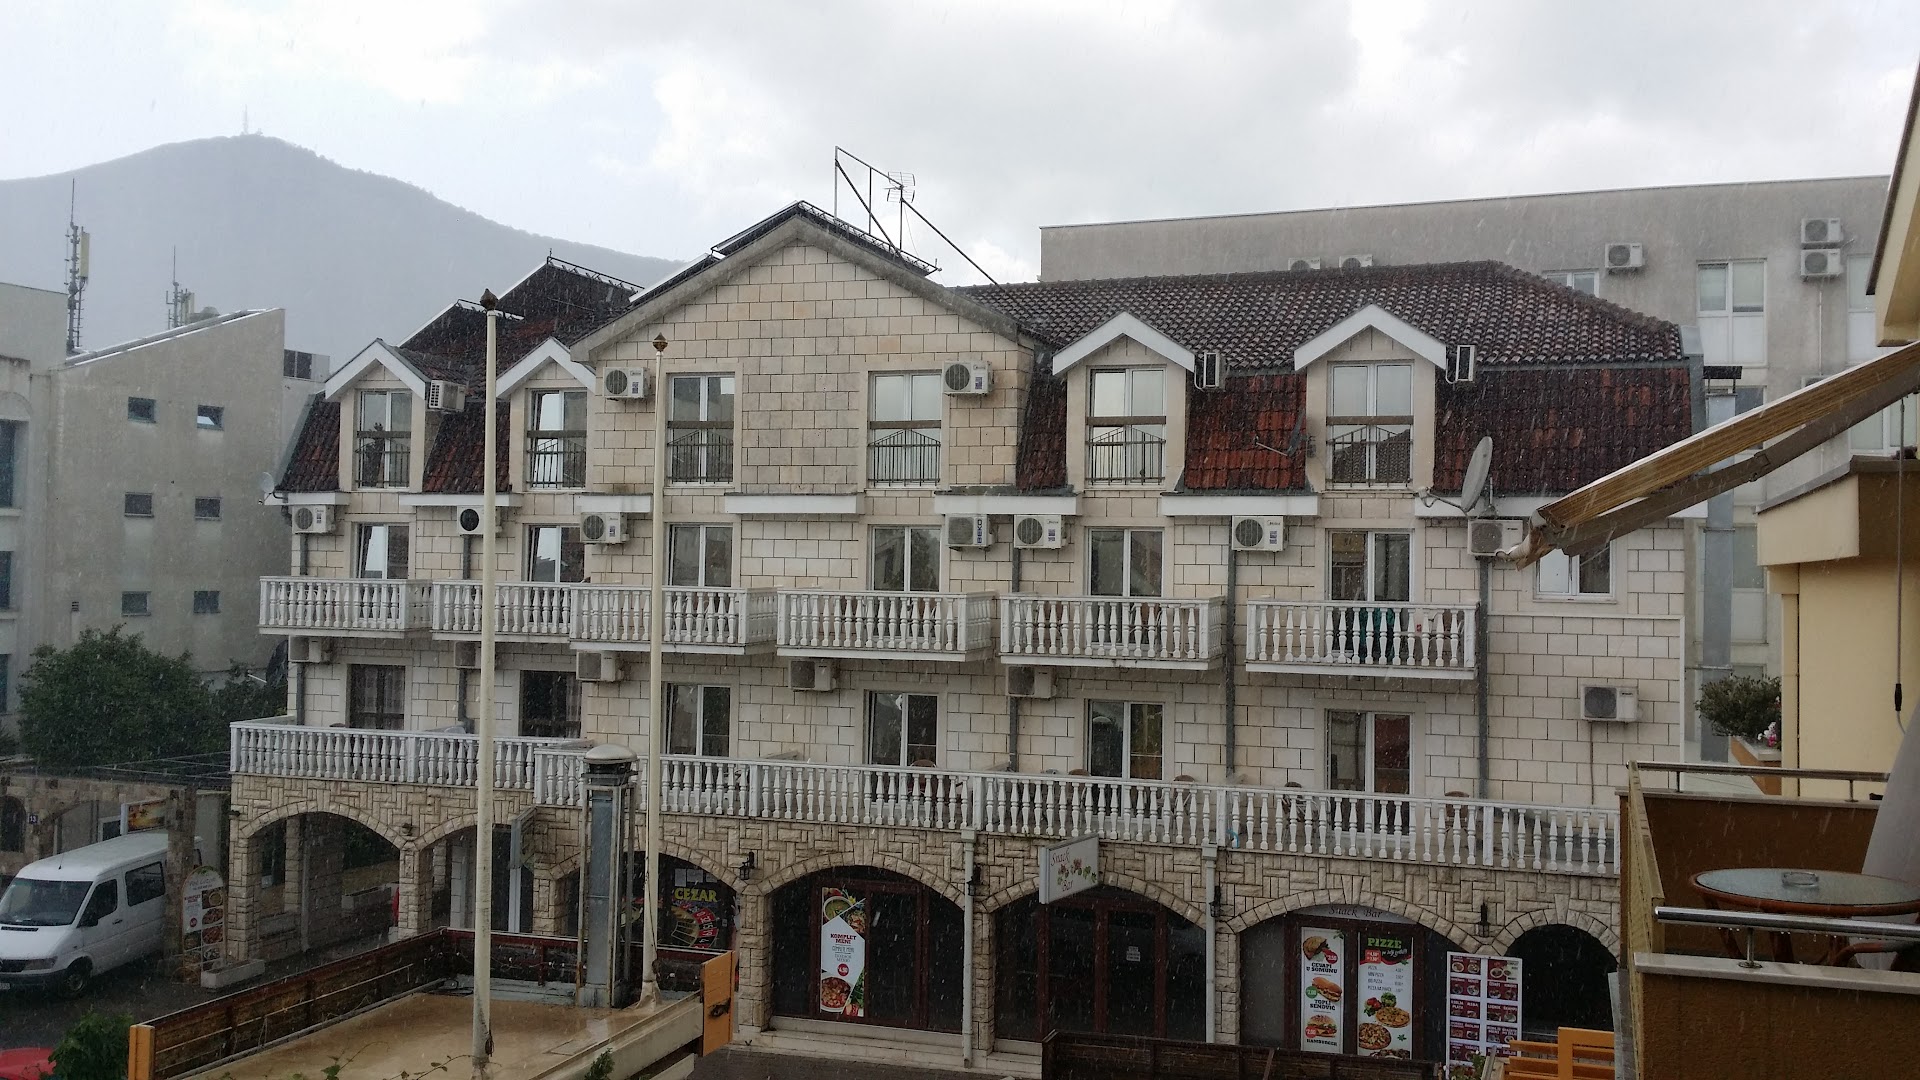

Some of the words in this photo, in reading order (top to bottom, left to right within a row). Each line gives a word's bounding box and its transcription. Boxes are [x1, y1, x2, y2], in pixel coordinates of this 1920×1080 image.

[1050, 847, 1070, 866] Snack
[1062, 880, 1073, 892] Bar
[674, 887, 718, 902] CEZAR
[1329, 905, 1359, 918] Snack
[1364, 909, 1383, 918] Bar
[1367, 937, 1402, 949] PIZZE
